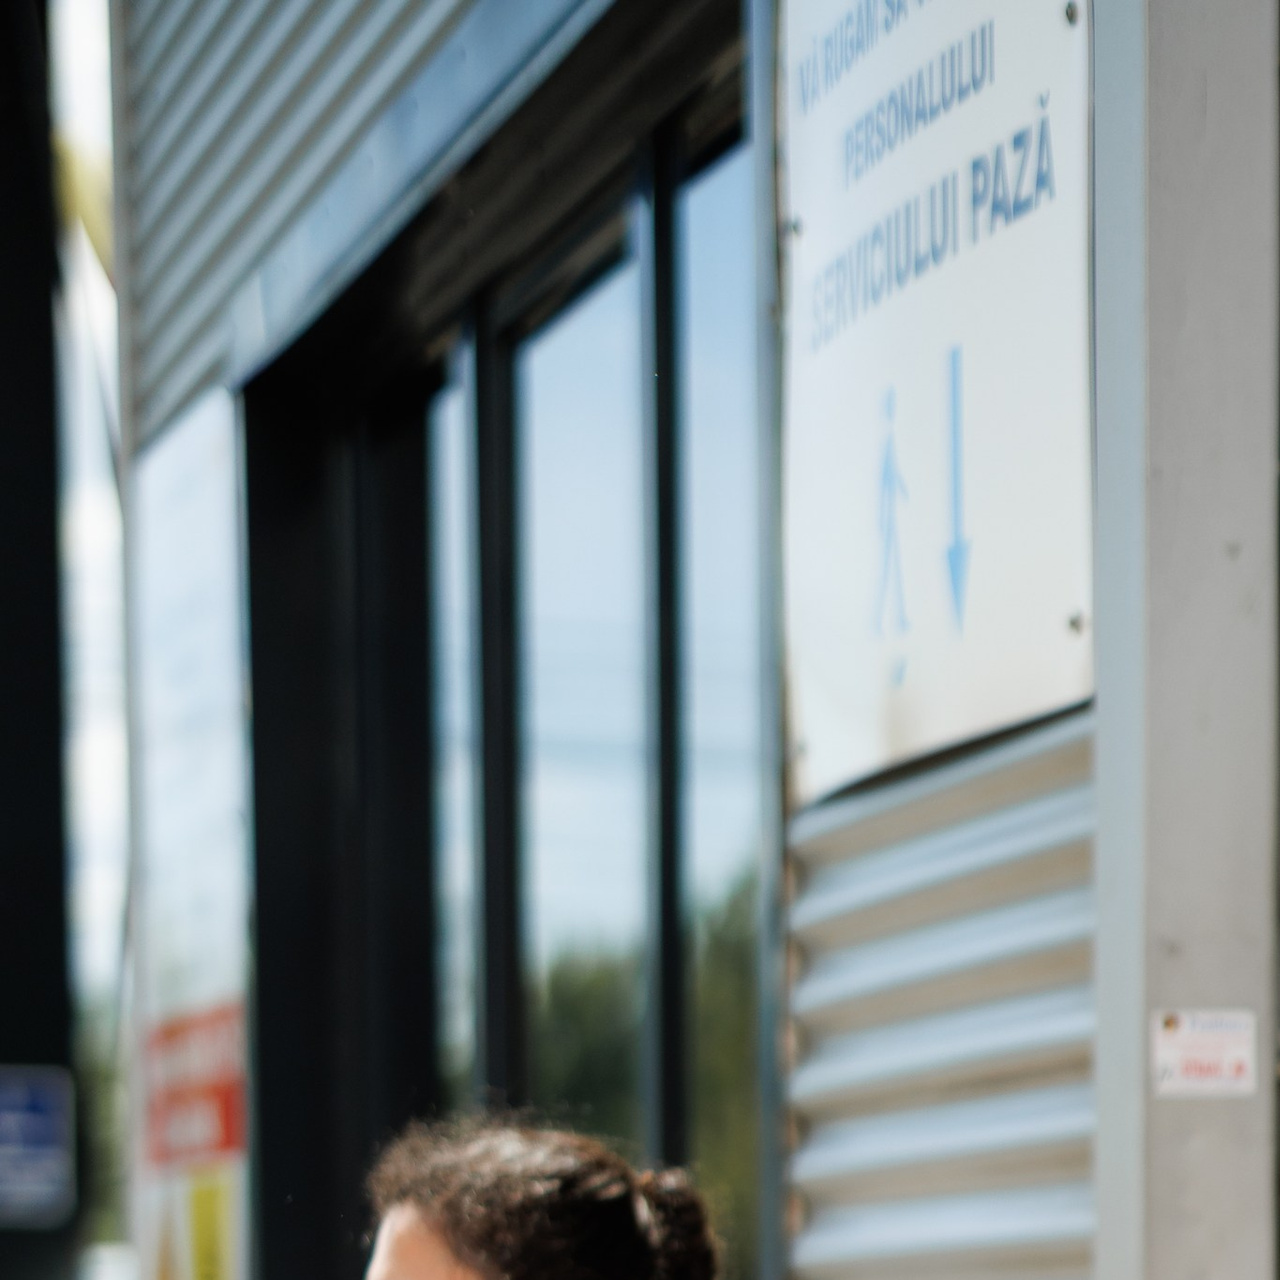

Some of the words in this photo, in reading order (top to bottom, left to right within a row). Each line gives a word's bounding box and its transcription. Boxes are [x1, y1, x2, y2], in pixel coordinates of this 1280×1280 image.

[844, 18, 995, 190] PERSONALULUI
[812, 170, 960, 354] SERVICIULUI
[971, 90, 1057, 246] PAZĂ
